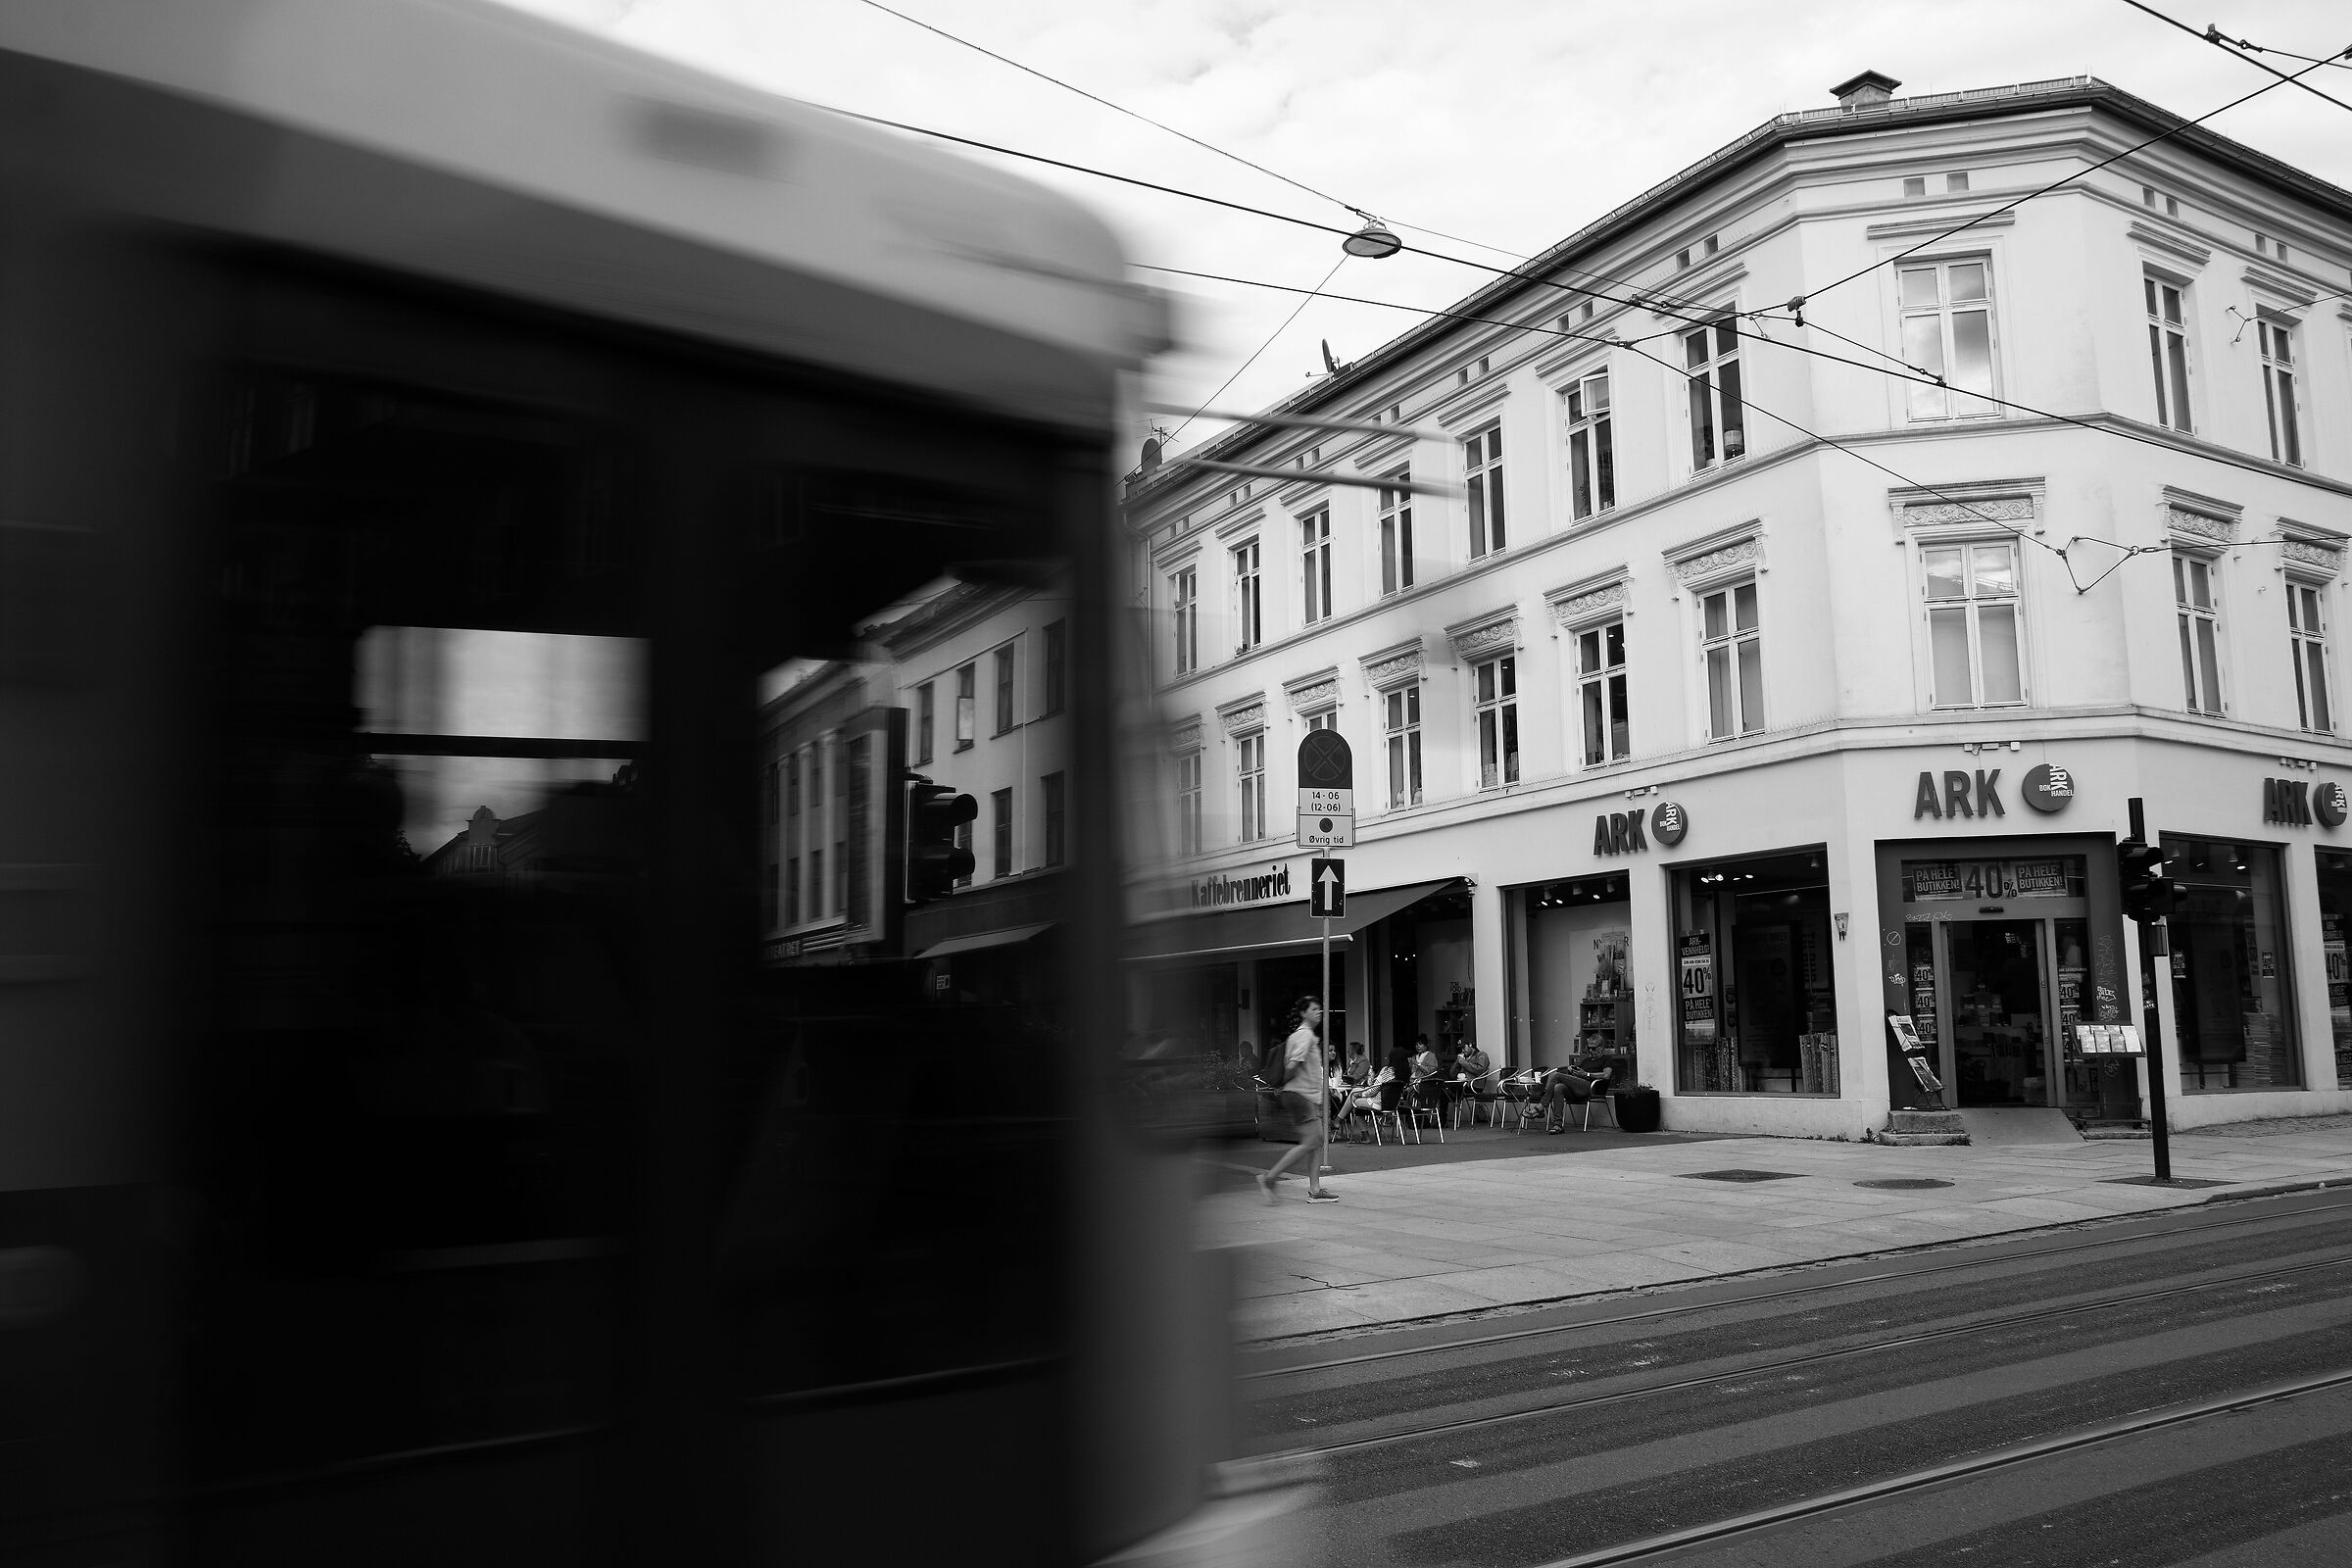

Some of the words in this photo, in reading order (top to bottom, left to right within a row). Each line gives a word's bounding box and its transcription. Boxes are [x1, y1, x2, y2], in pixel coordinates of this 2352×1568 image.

[2049, 764, 2068, 791] ARK
[1914, 769, 2006, 817] ARK
[2264, 778, 2313, 825] ARK
[1666, 802, 1677, 825] ARK
[1308, 835, 1330, 845] Øvrig
[1333, 835, 1344, 844] tid
[1593, 808, 1647, 855] ARK
[1191, 863, 1291, 908] Kaffebrenneriet
[1917, 879, 1960, 892] BUTIKKEN!
[2019, 876, 2063, 889] BUTIKKEN!
[1683, 966, 1711, 994] 40%
